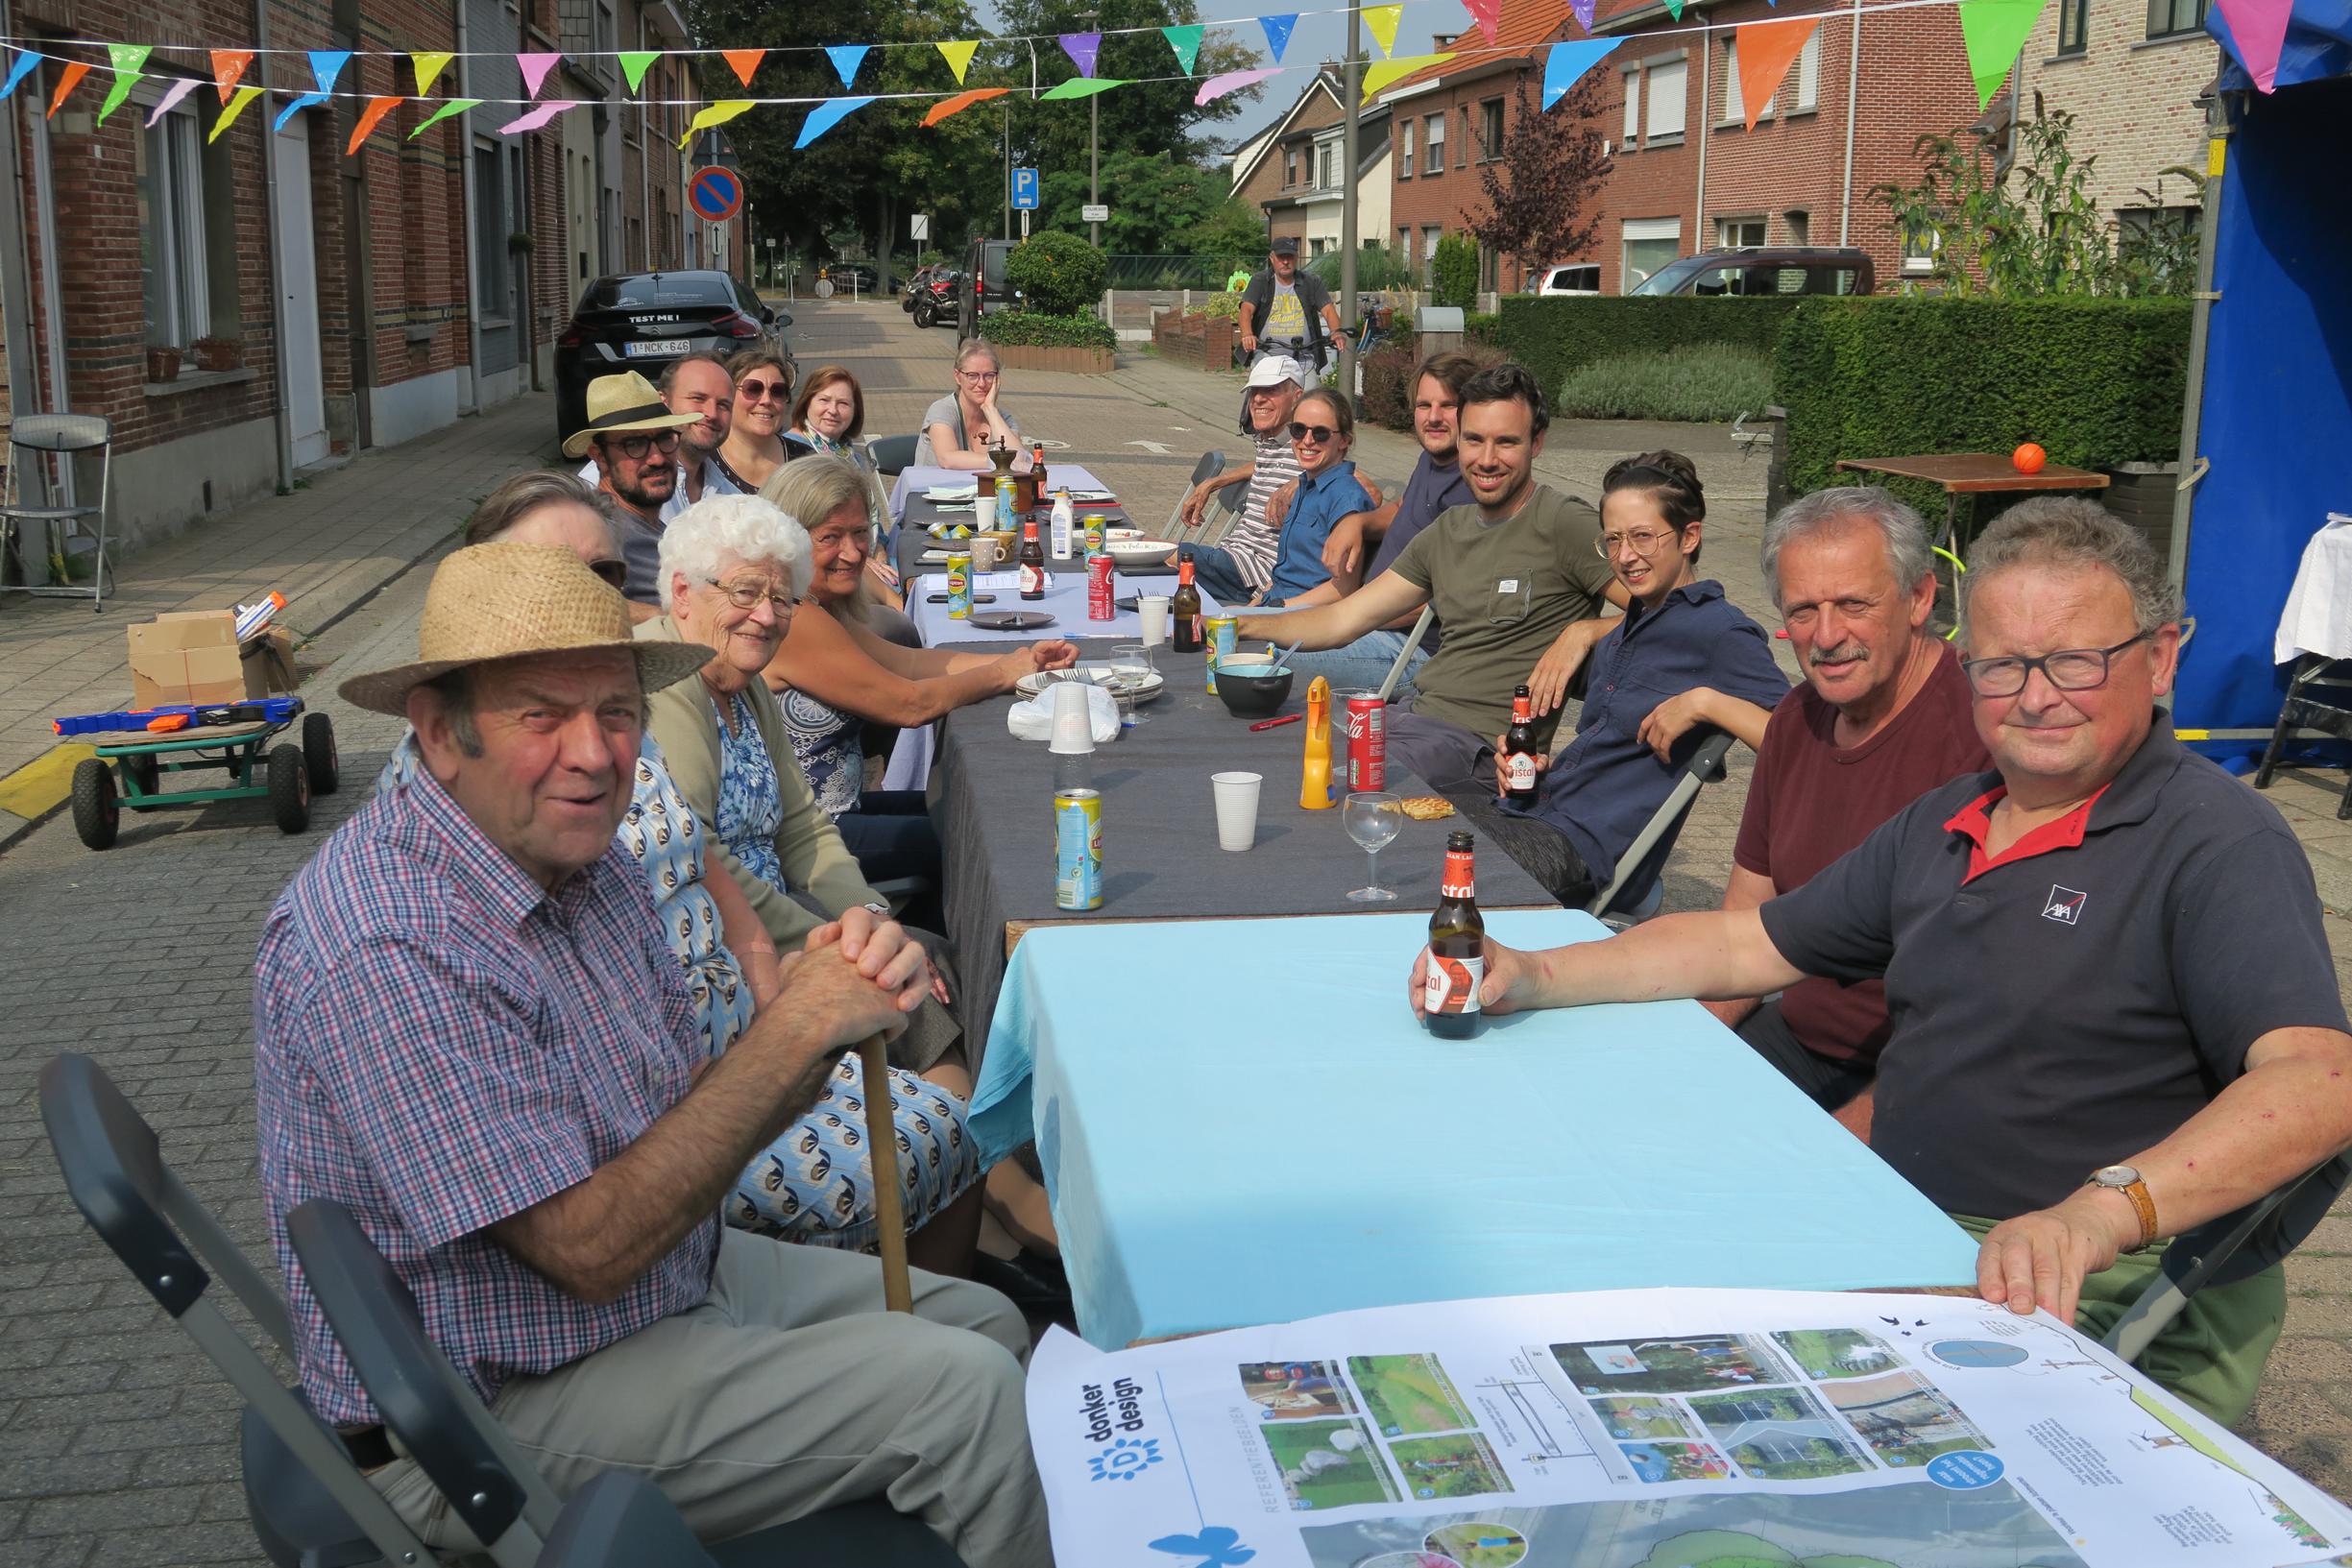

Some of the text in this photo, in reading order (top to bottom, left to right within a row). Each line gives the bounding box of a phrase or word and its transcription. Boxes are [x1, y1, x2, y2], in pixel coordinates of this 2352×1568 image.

[1017, 172, 1032, 192] P
[629, 315, 655, 324] TEST
[1512, 767, 1534, 777] ristal
[2049, 903, 2071, 920] AXA
[1426, 975, 1441, 992] tal
[1079, 1384, 1113, 1442] donker
[1107, 1377, 1144, 1432] design
[1228, 1406, 1280, 1513] REFERENTIEBEELDEN
